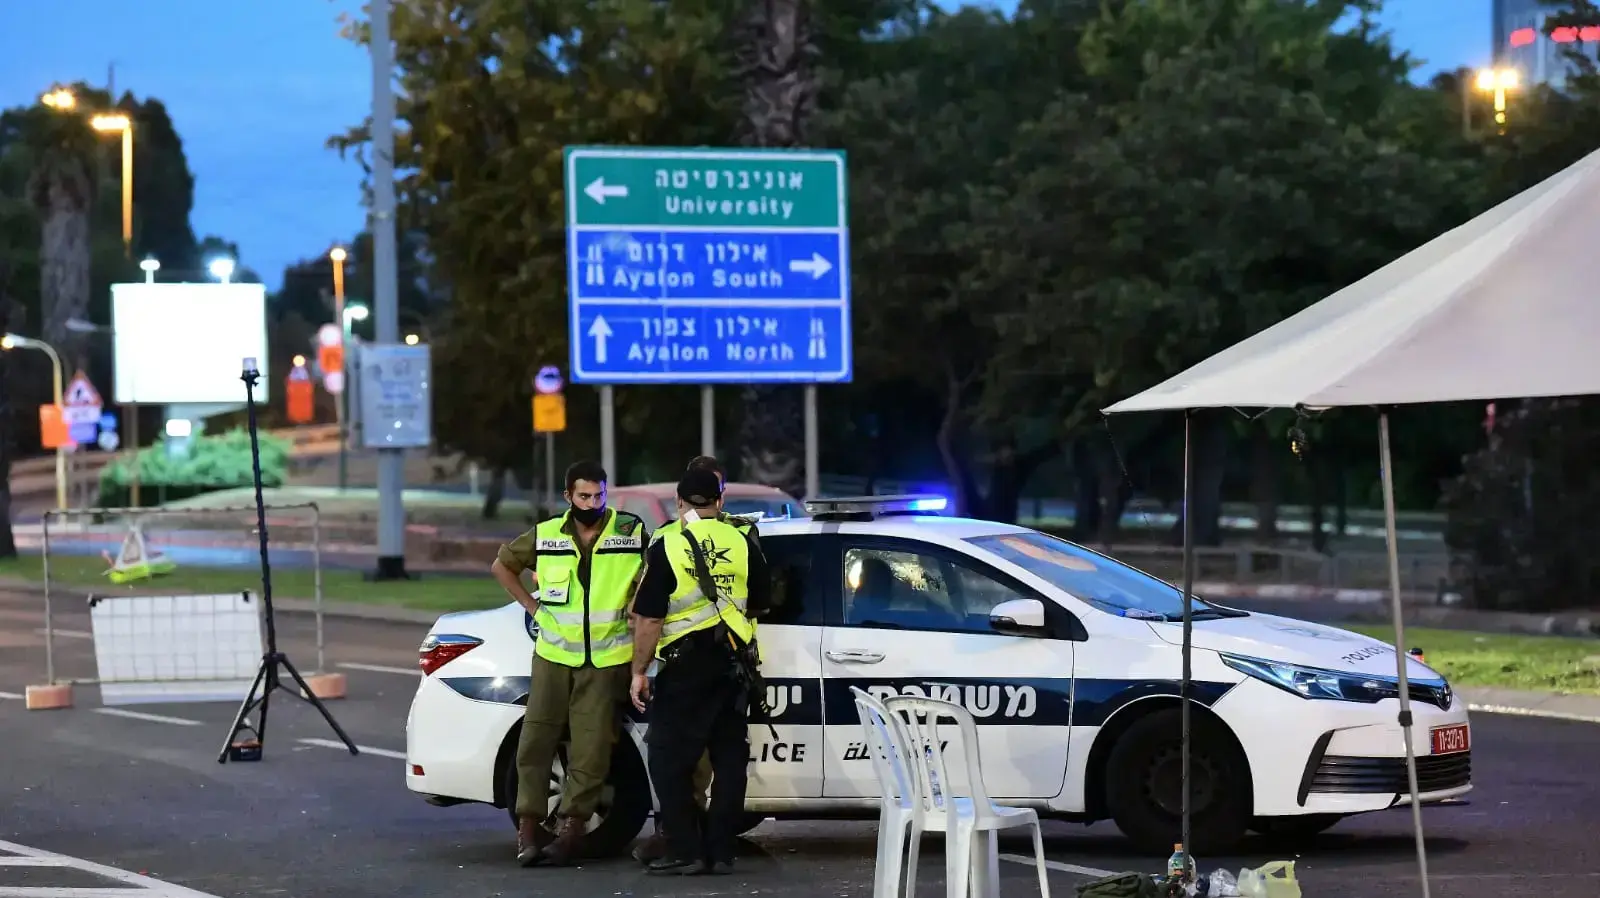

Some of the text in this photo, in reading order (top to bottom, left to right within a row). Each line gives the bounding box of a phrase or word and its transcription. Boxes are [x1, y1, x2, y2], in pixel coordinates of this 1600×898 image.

[655, 169, 803, 190] אוניברסיטה
[665, 195, 794, 219] University
[627, 242, 768, 264] אילון דרום
[613, 267, 783, 291] Ayalon South
[641, 316, 778, 339] אילון צפון
[627, 342, 795, 365] Ayalon North
[604, 538, 635, 546] משטרה
[748, 743, 806, 762] LICE
